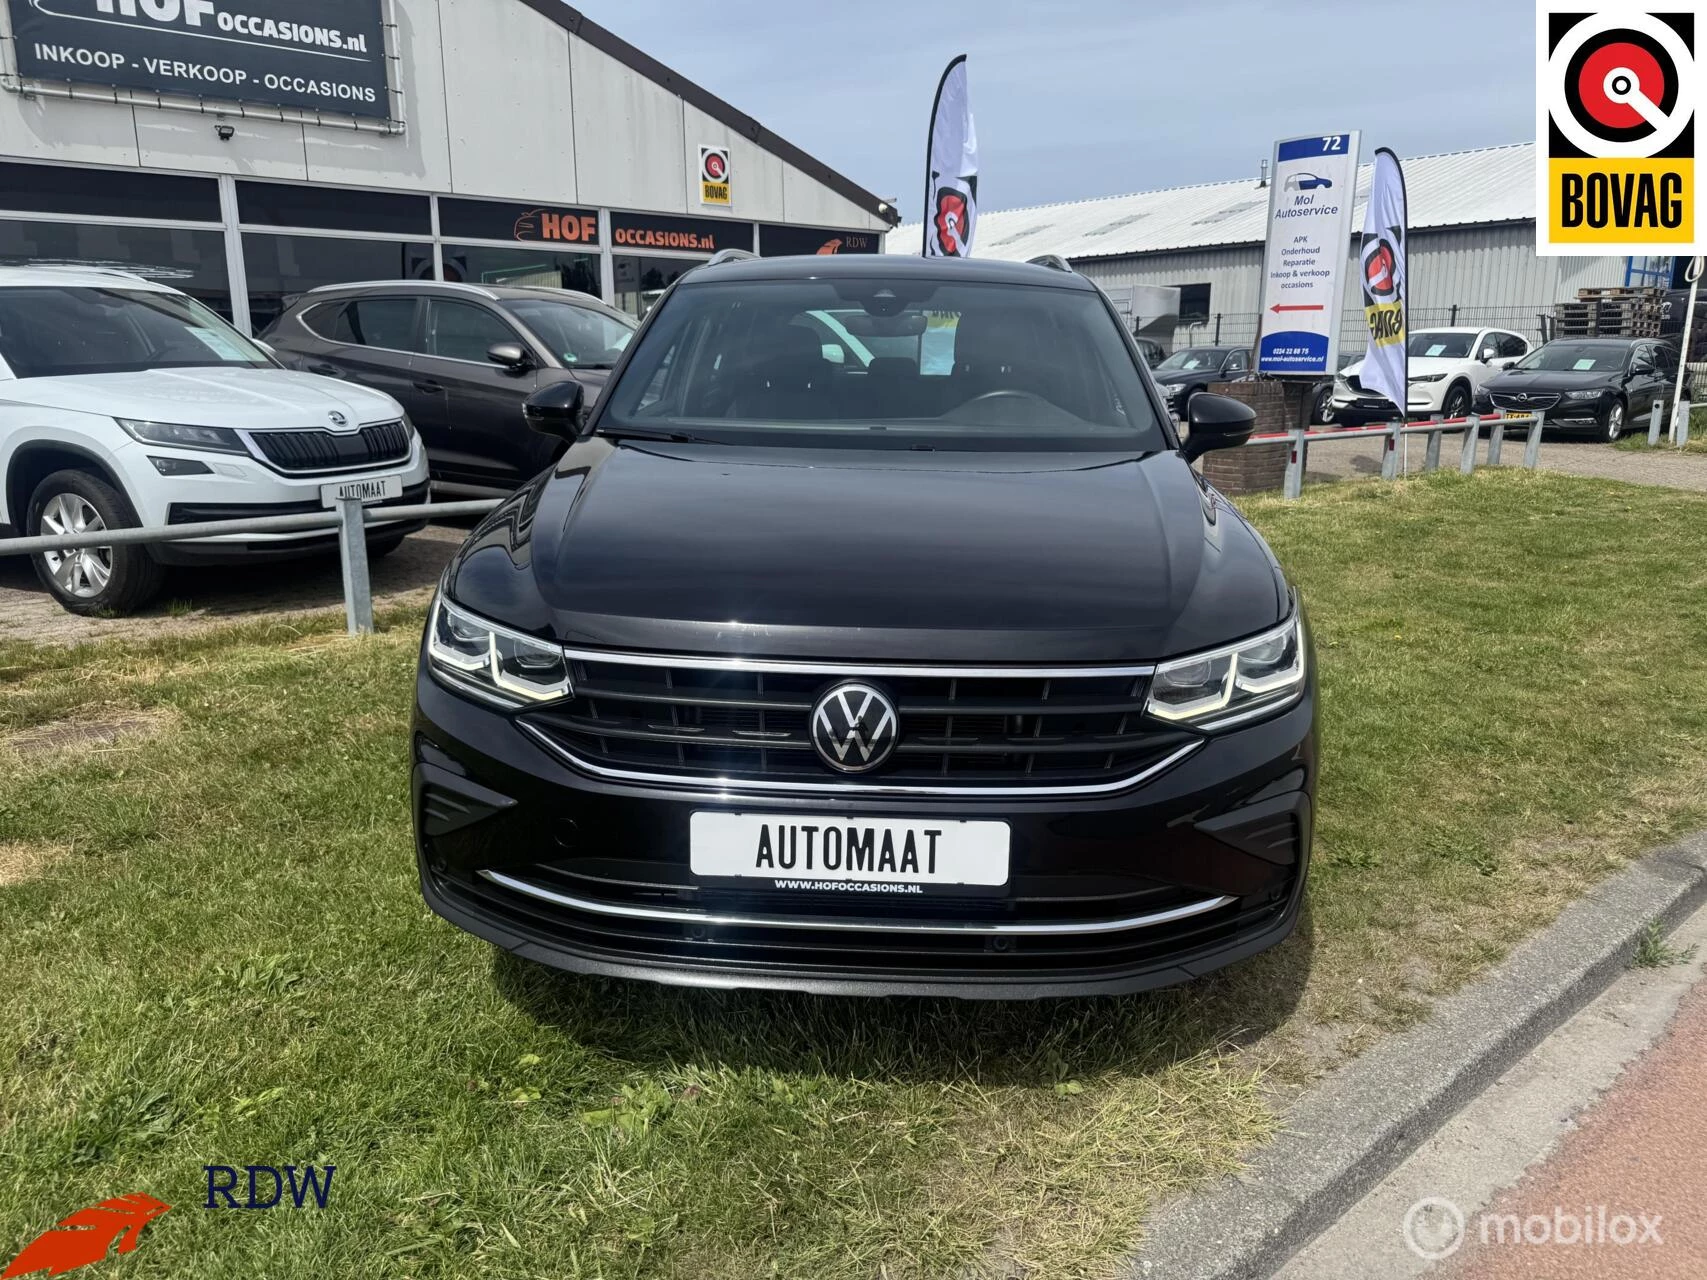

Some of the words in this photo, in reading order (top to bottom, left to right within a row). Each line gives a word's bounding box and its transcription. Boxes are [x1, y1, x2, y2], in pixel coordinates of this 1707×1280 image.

[216, 11, 367, 53] OCCASIONS.nl
[35, 42, 125, 69] INKOOP
[143, 57, 247, 85] VERKOOP
[264, 74, 376, 103] OCCASIONS
[1322, 136, 1341, 151] 72
[704, 184, 728, 200] BOVAG
[1294, 194, 1314, 206] Mol
[1275, 205, 1338, 219] Autoservice
[541, 212, 597, 242] HOF
[615, 228, 715, 249] OCCASIONS.nl
[846, 237, 868, 249] RDW
[1293, 235, 1308, 244] APK
[1281, 246, 1320, 256] Onderhoud
[1283, 258, 1316, 269] Reparatie
[1270, 271, 1291, 280] Inkoop
[1299, 269, 1330, 278] verkoop
[1281, 281, 1314, 289] occasions
[339, 480, 386, 499] AUTOMAAT
[755, 824, 942, 874] AUTOMAAT
[774, 879, 923, 894] WWW.HOFOCCASIONS.NL
